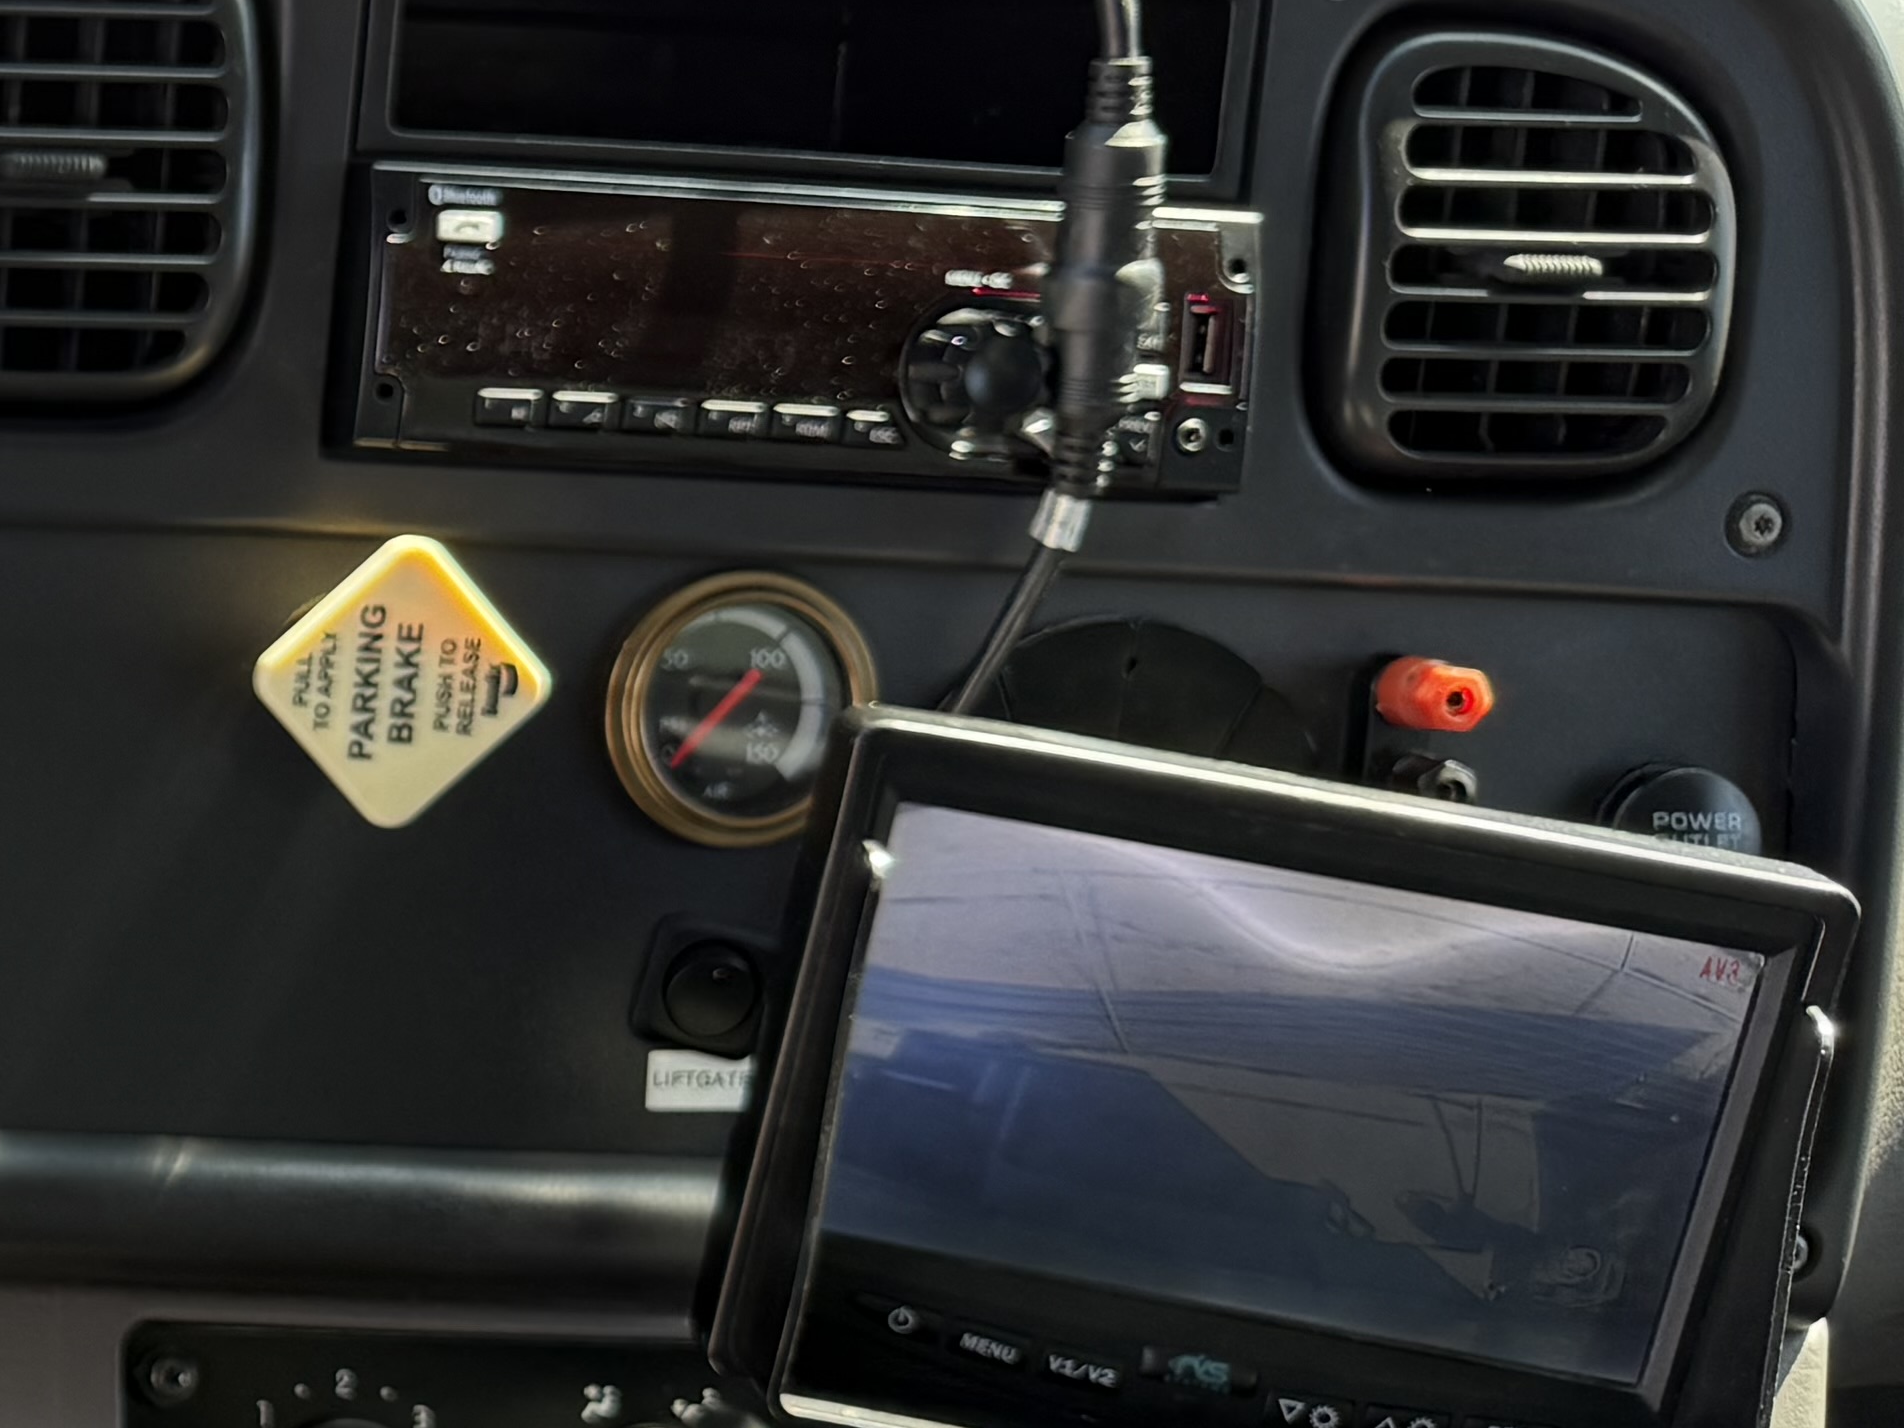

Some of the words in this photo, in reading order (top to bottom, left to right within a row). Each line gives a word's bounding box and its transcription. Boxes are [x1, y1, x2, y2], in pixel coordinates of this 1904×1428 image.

[439, 637, 458, 667] TO
[749, 646, 787, 669] 100
[292, 651, 314, 708] PULL
[314, 702, 330, 732] TO
[322, 629, 339, 700] APPLY
[347, 602, 387, 762] PARKING
[387, 622, 424, 745] BRAKE
[455, 636, 483, 737] RELEASE
[433, 671, 454, 733] PUSH
[745, 742, 780, 765] 150
[1652, 811, 1742, 831] POWER
[1654, 832, 1742, 851] UTLET
[1699, 955, 1740, 985] AV3
[960, 1331, 1023, 1366] MENU
[334, 1368, 358, 1400] 2
[1048, 1353, 1118, 1389] V1/V2
